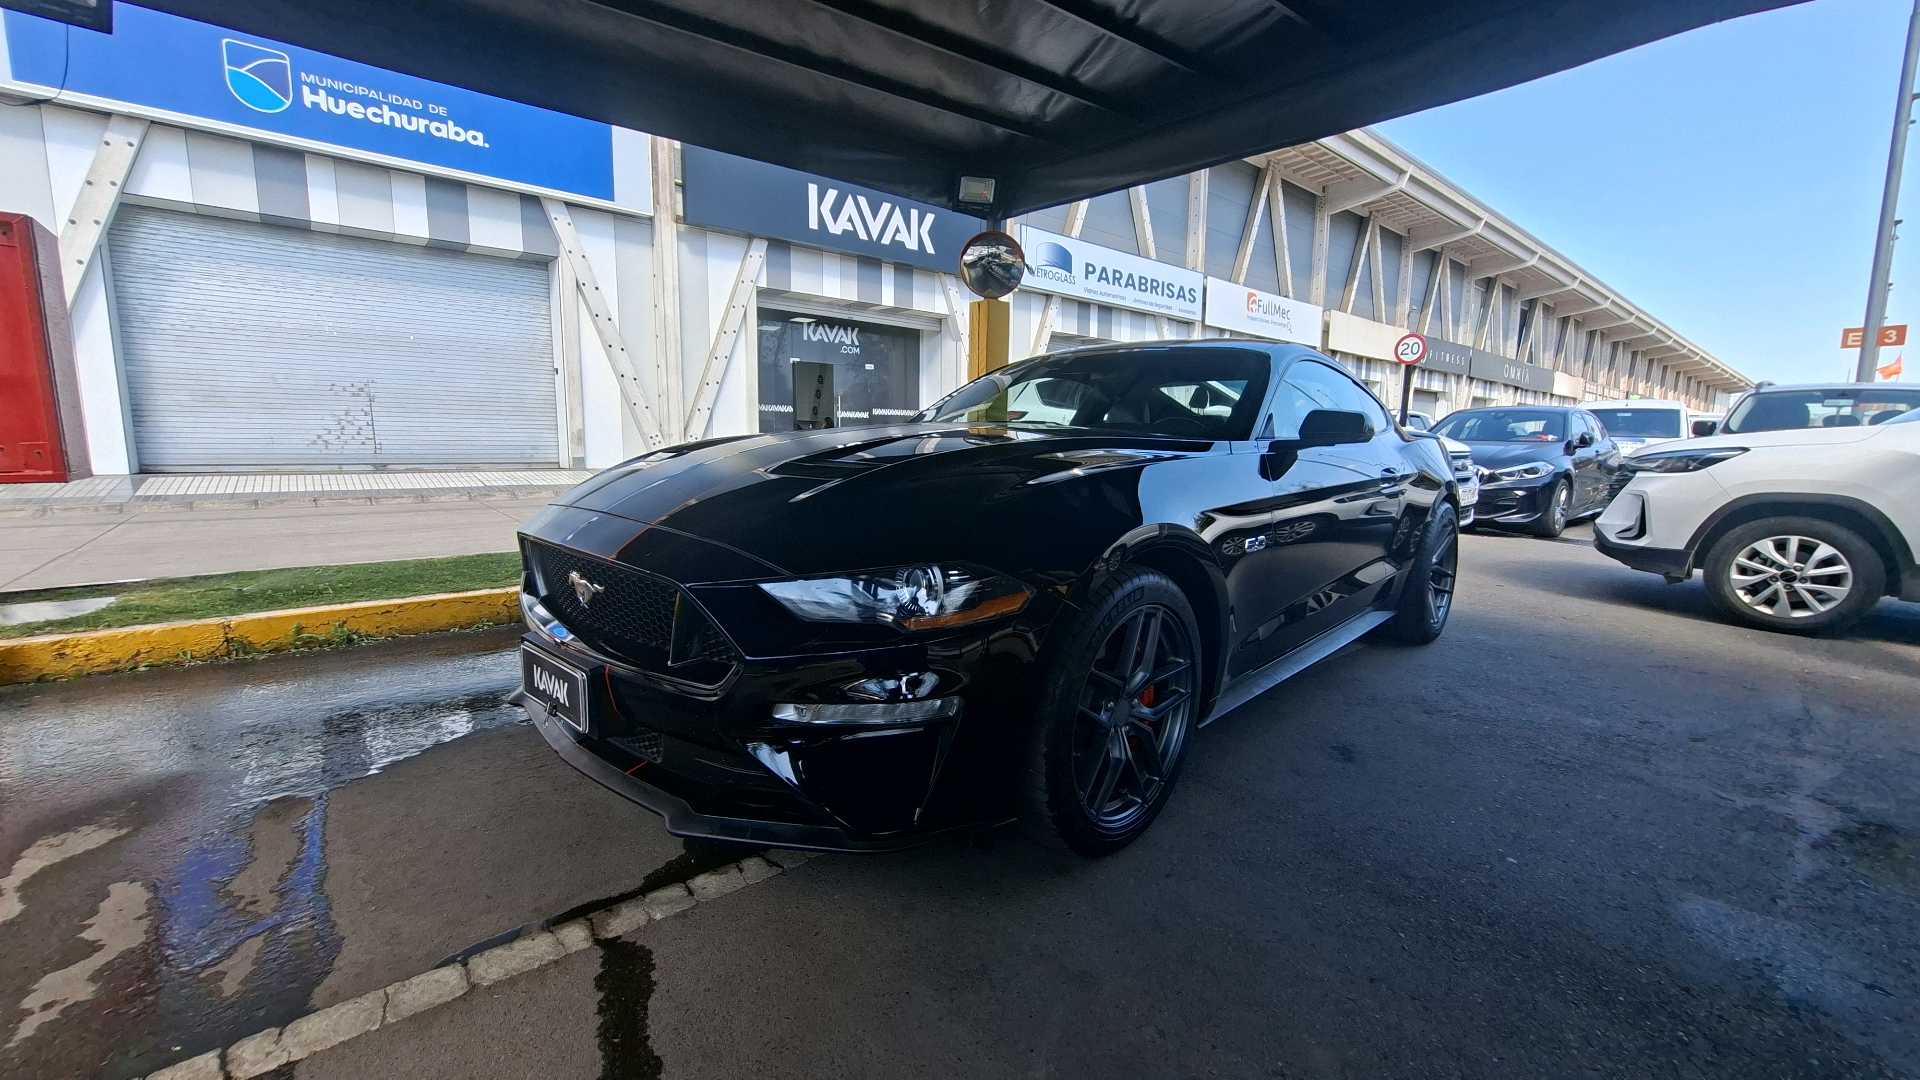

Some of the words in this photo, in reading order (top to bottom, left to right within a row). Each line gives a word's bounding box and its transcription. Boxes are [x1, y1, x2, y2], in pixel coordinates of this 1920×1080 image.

[300, 71, 423, 111] MUNICIPALIDAD
[428, 103, 448, 117] DE
[302, 84, 490, 149] Huechuraba.
[807, 182, 936, 255] KAVAK
[1084, 262, 1197, 304] PARABRISAS
[1257, 299, 1291, 321] FullMec
[803, 321, 860, 346] KAVAK
[1399, 341, 1420, 356] 20
[1847, 332, 1863, 346] E
[1883, 329, 1897, 343] 3
[533, 663, 569, 708] KAVAK
